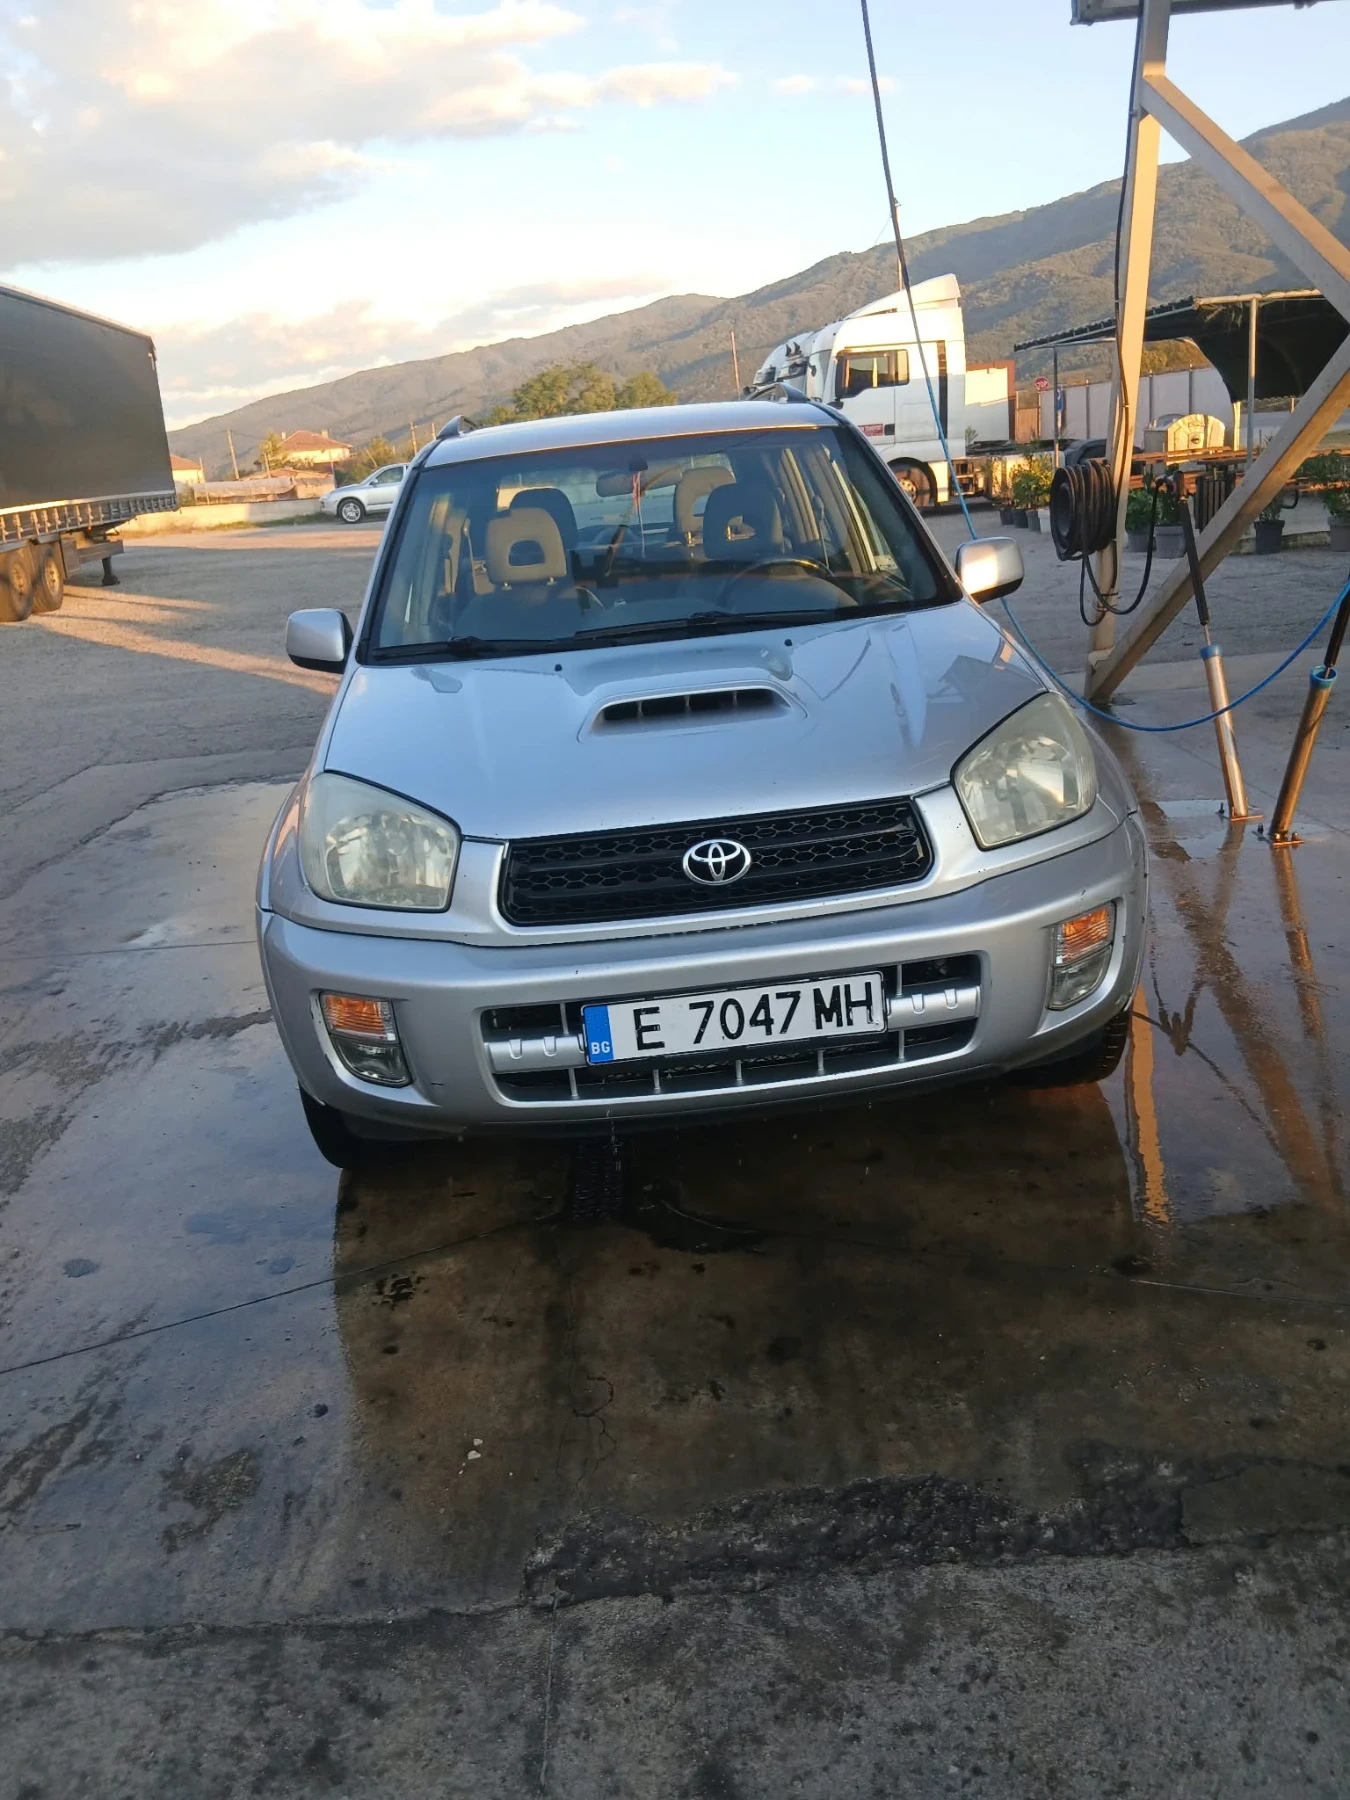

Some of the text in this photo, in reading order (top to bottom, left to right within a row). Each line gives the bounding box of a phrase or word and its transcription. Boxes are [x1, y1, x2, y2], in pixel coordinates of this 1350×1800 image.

[633, 981, 874, 1050] E 7047 MH
[591, 1041, 611, 1055] BG
